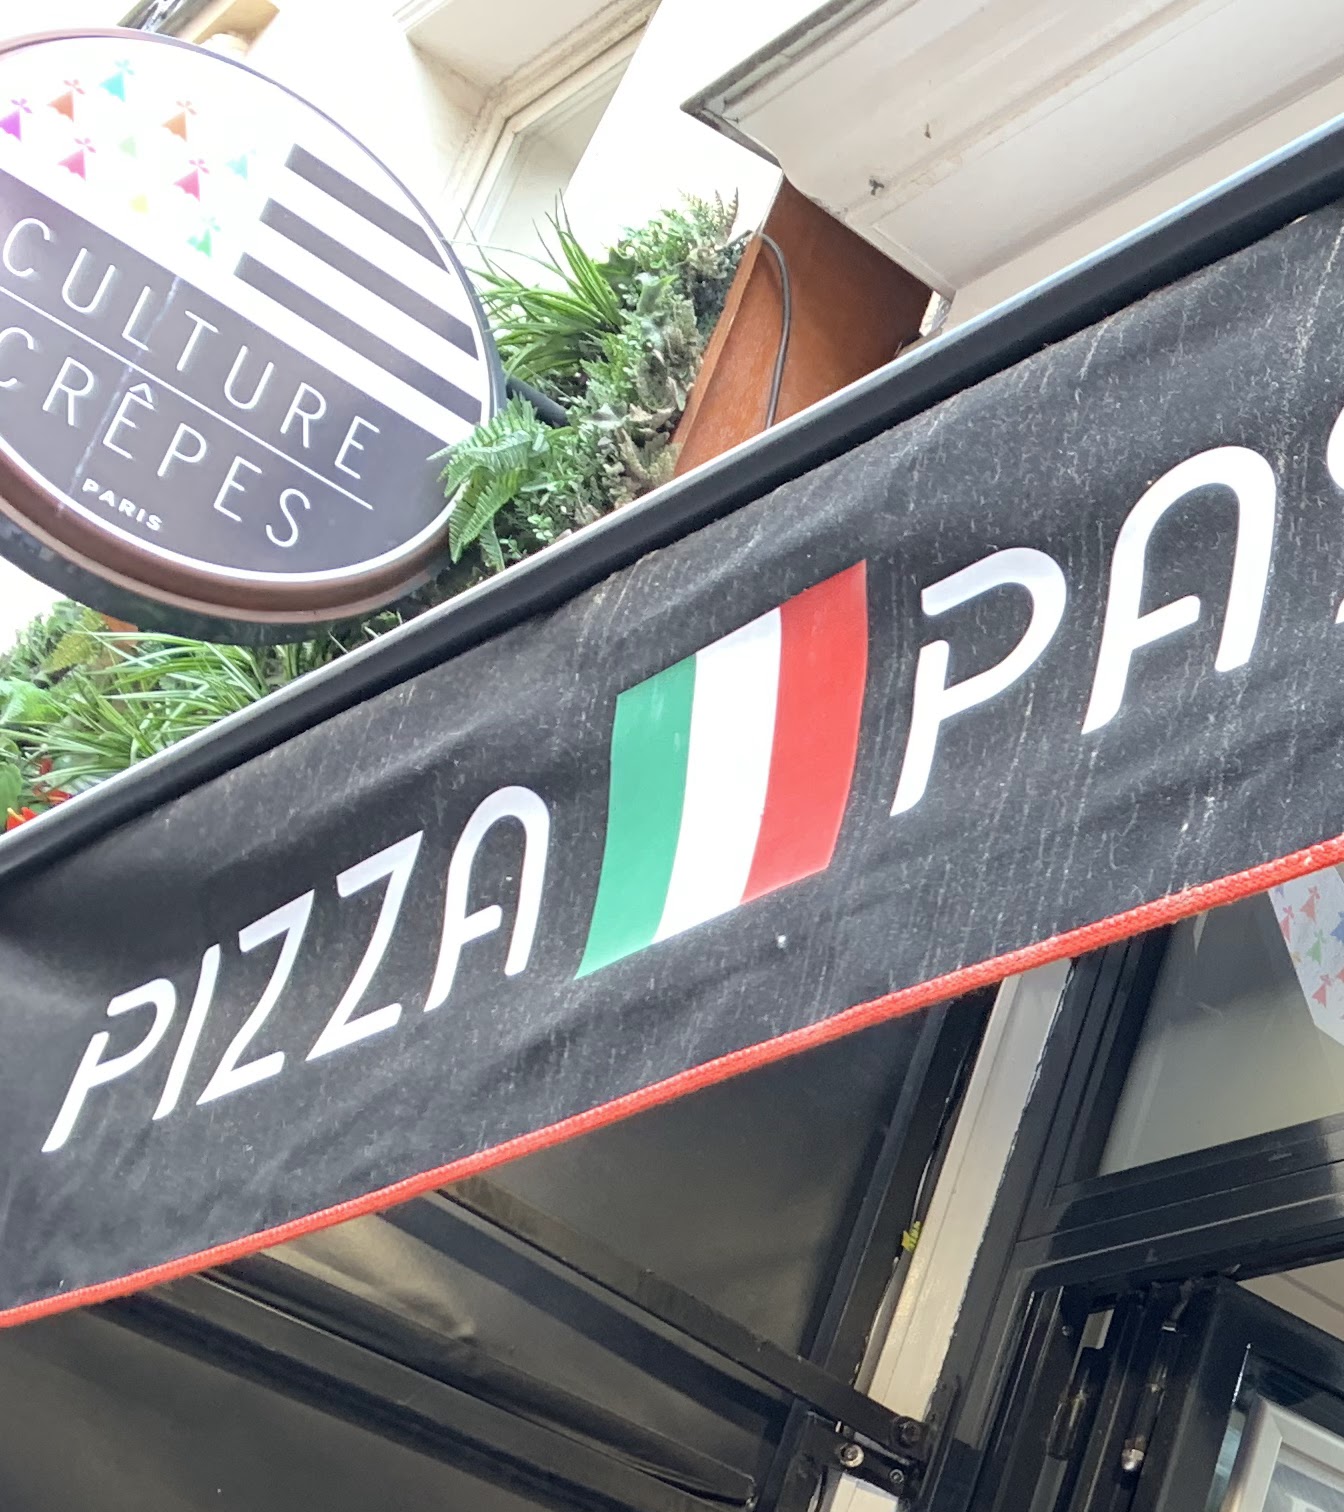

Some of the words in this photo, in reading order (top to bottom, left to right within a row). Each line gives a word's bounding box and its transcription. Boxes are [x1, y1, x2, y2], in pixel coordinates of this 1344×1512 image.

[0, 326, 310, 548] CRÊPES
[3, 218, 380, 480] CULTURE
[83, 478, 162, 533] PARIS
[41, 785, 551, 1152] PIZZA
